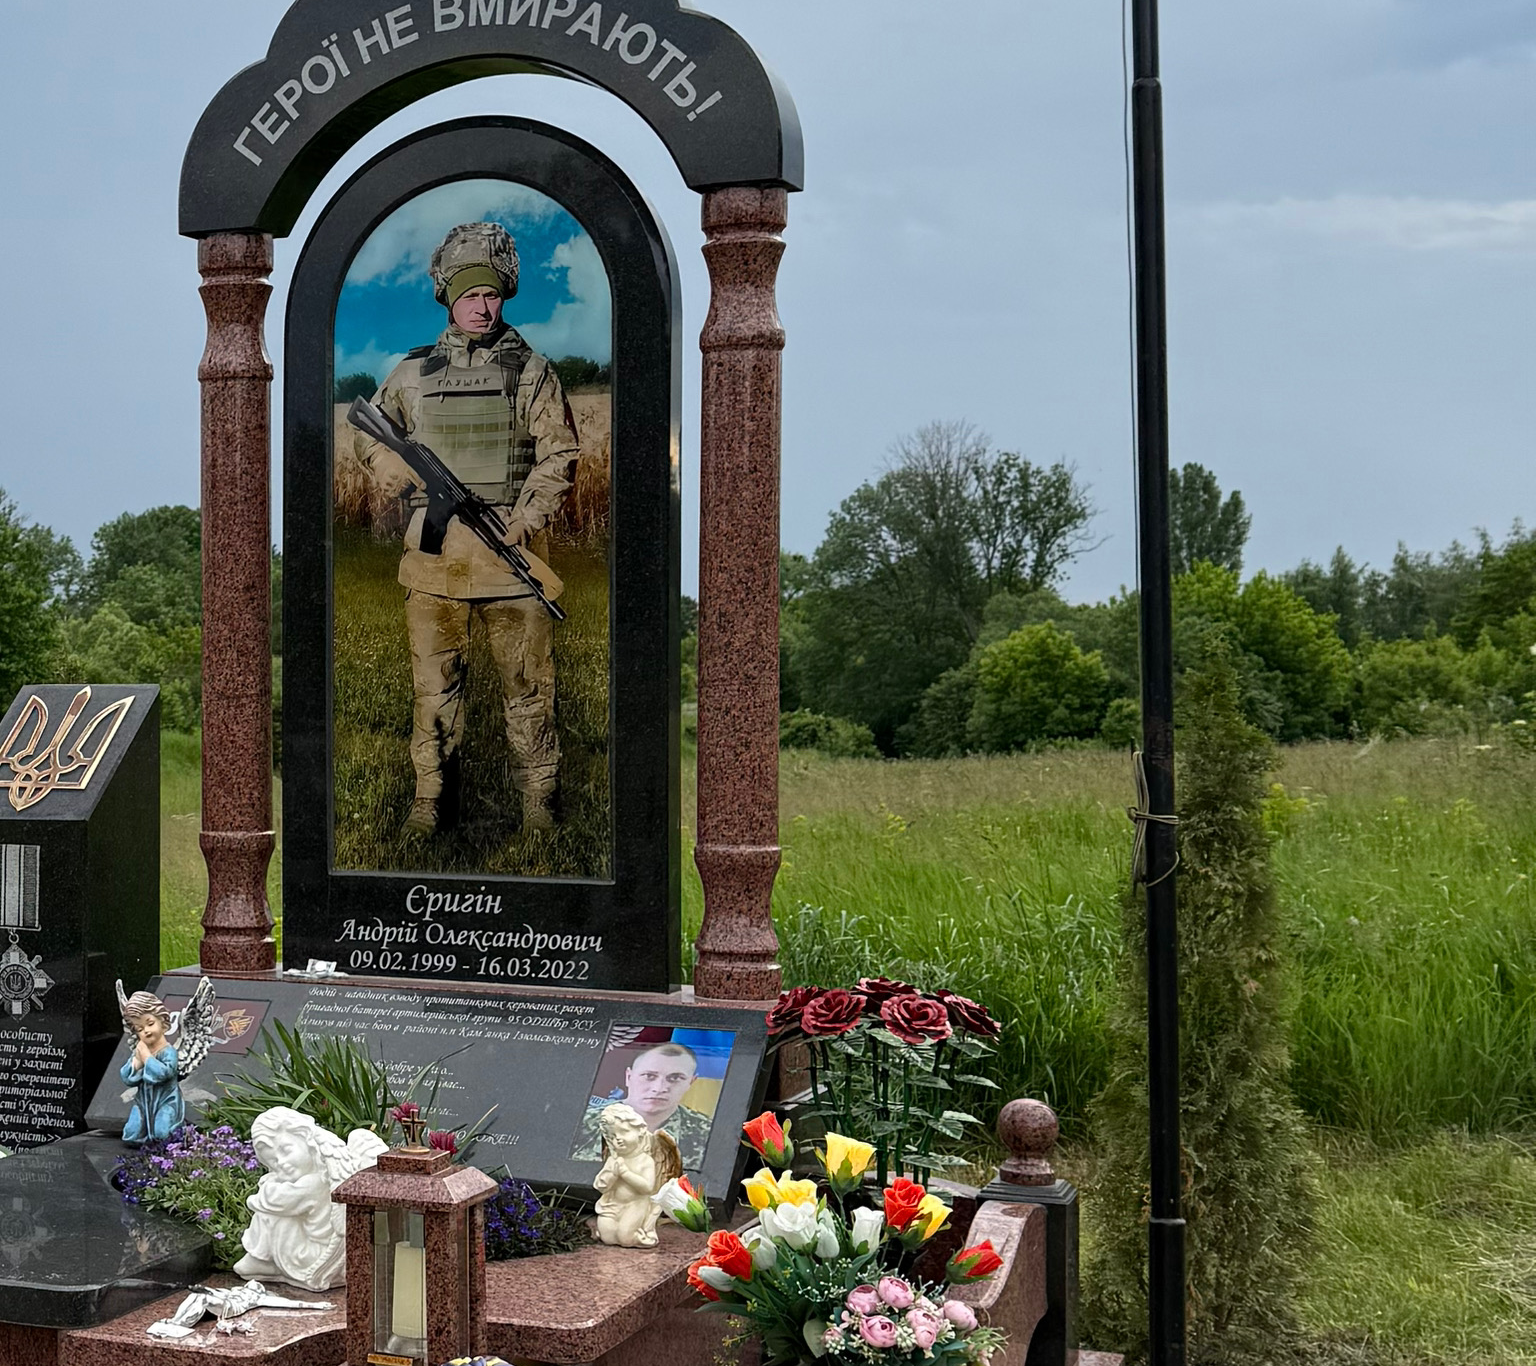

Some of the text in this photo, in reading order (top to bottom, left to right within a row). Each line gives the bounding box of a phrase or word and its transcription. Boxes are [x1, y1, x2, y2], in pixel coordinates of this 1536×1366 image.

[232, 33, 351, 167] ГЕРОЇ
[353, 4, 420, 65] НЕ
[437, 377, 491, 387] ГЛУШАК
[405, 885, 503, 921] Єригін
[334, 916, 604, 957] Андрій Олександрович
[349, 949, 457, 973] 09.02.1999
[476, 956, 590, 981] 16.03.2022
[308, 986, 337, 998] Водій
[344, 989, 390, 1002] навідник
[422, 995, 506, 1010] протитанкових
[505, 1001, 561, 1013] керованих
[559, 1004, 595, 1016] ракет
[302, 1000, 353, 1014] бригадної
[352, 1003, 394, 1019] батареї
[391, 1008, 472, 1024] артилерійської
[470, 1014, 503, 1026] групи
[505, 1015, 522, 1025] 95
[569, 1019, 601, 1033] ЗСУ.
[0, 1026, 53, 1046] особисту
[298, 1016, 335, 1029] агинув
[335, 1017, 353, 1028] під
[354, 1021, 371, 1029] час
[371, 1019, 392, 1031] бою
[401, 1023, 441, 1035] районі
[512, 1030, 575, 1045] Ізюмського
[574, 1037, 601, 1049] р-ну
[20, 1042, 25, 1053] і
[26, 1045, 67, 1059] героїзм,
[13, 1058, 21, 1070] у
[22, 1059, 64, 1071] захисті
[11, 1073, 76, 1089] суверенітету
[18, 1099, 65, 1115] України,
[31, 1114, 75, 1129] орденом
